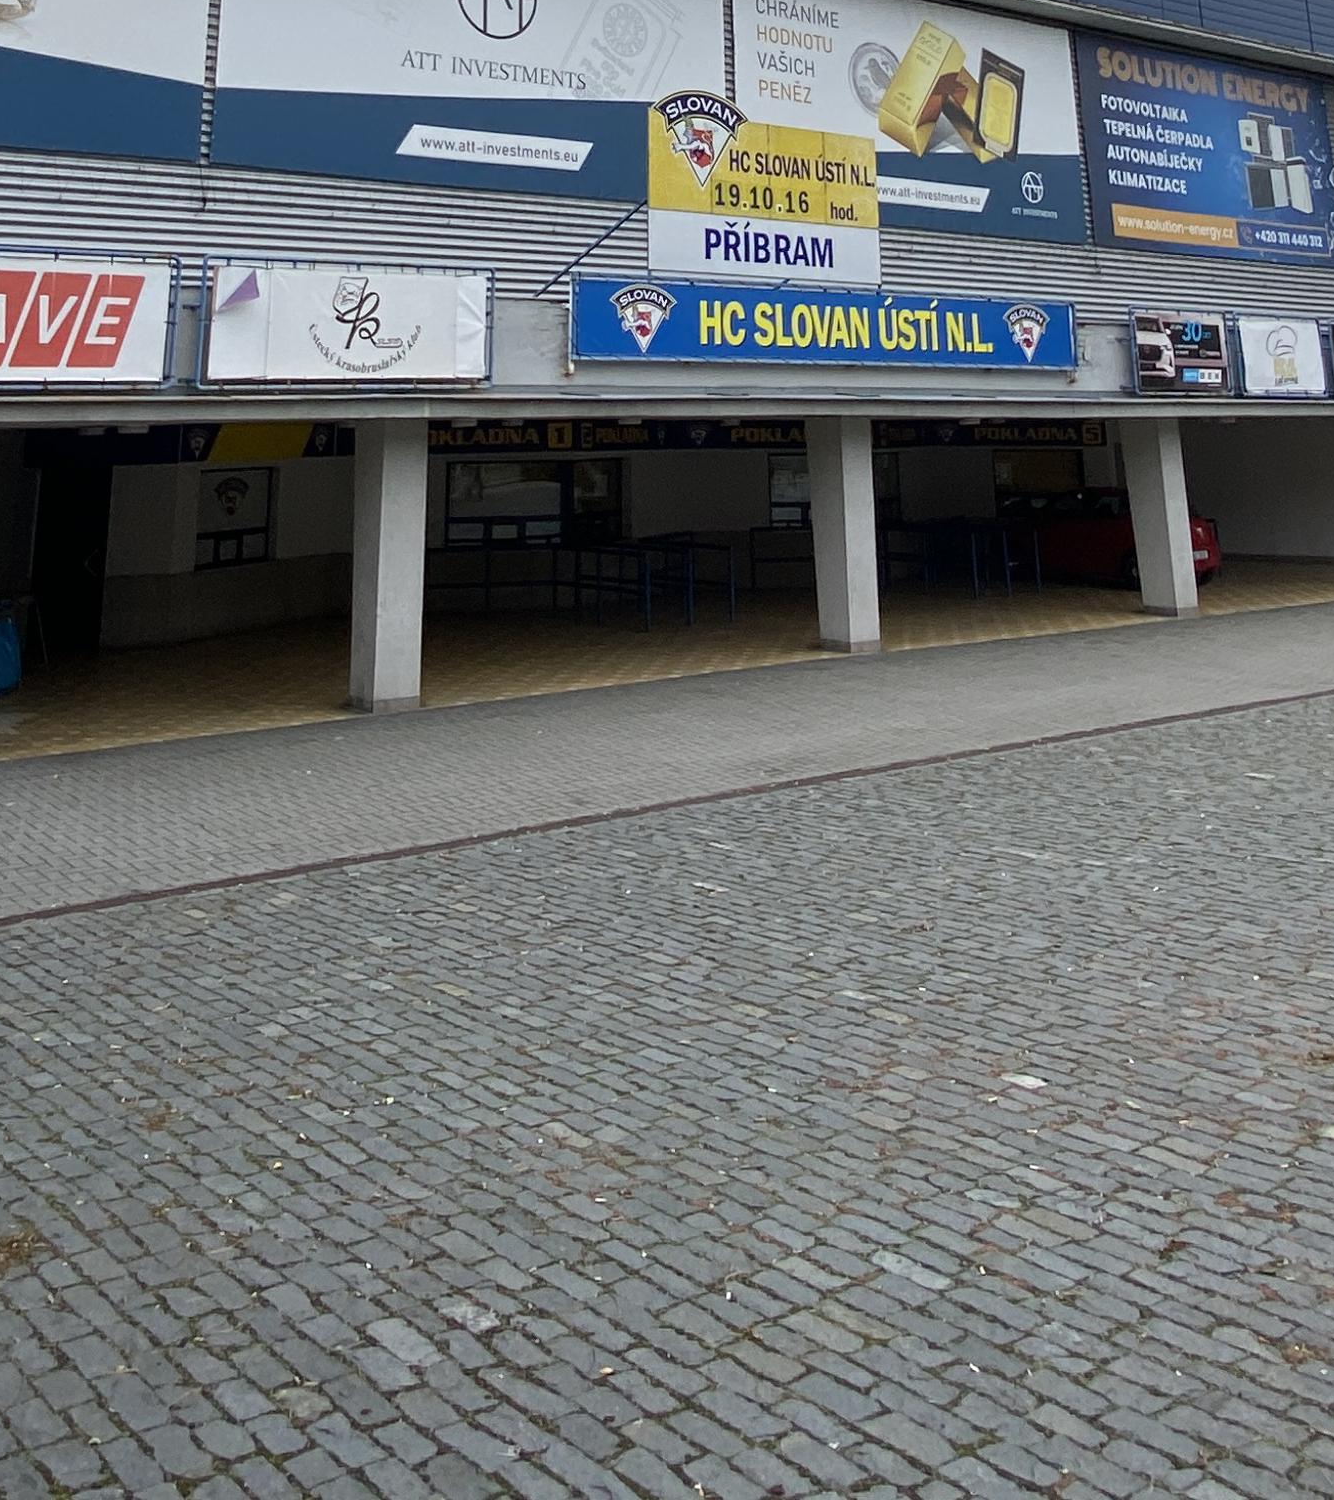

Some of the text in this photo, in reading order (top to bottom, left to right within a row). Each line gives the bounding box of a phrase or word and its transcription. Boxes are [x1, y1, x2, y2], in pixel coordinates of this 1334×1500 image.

[756, 24, 833, 53] HODNOTU
[401, 50, 442, 71] ATT
[451, 56, 587, 90] INVESTMENTS
[757, 50, 816, 77] VAŠICH
[758, 79, 812, 104] PENĚZ
[1097, 46, 1309, 113] SOLUTION ENERGY
[665, 97, 738, 128] SLOVAN
[1101, 94, 1188, 123] FOTOVOLTAIKA
[1103, 117, 1214, 150] TEPELNÁ ČERPADLA
[420, 136, 579, 163] www.att-investments.eu
[1107, 143, 1203, 172] AUTONABÍJEČKY
[729, 149, 875, 188] HC SLOVAN ÚSTÍ N.L.
[1108, 169, 1188, 195] KLIMATIZACE
[714, 183, 810, 214] 19.10.16
[830, 202, 859, 222] hod.
[1117, 215, 1234, 241] www.solution-energy.cz
[1255, 232, 1277, 244] +420
[1291, 235, 1309, 247] 440
[1308, 235, 1324, 248] 312
[704, 220, 835, 268] PŘÍBRAM
[619, 288, 669, 308] SLOVAN
[699, 297, 994, 353] HC SLOVAN ÚSTÍ N.L.
[1007, 305, 1044, 324] SLOVAN
[731, 427, 805, 443] POKLA
[973, 427, 1077, 442] POKLADNA
